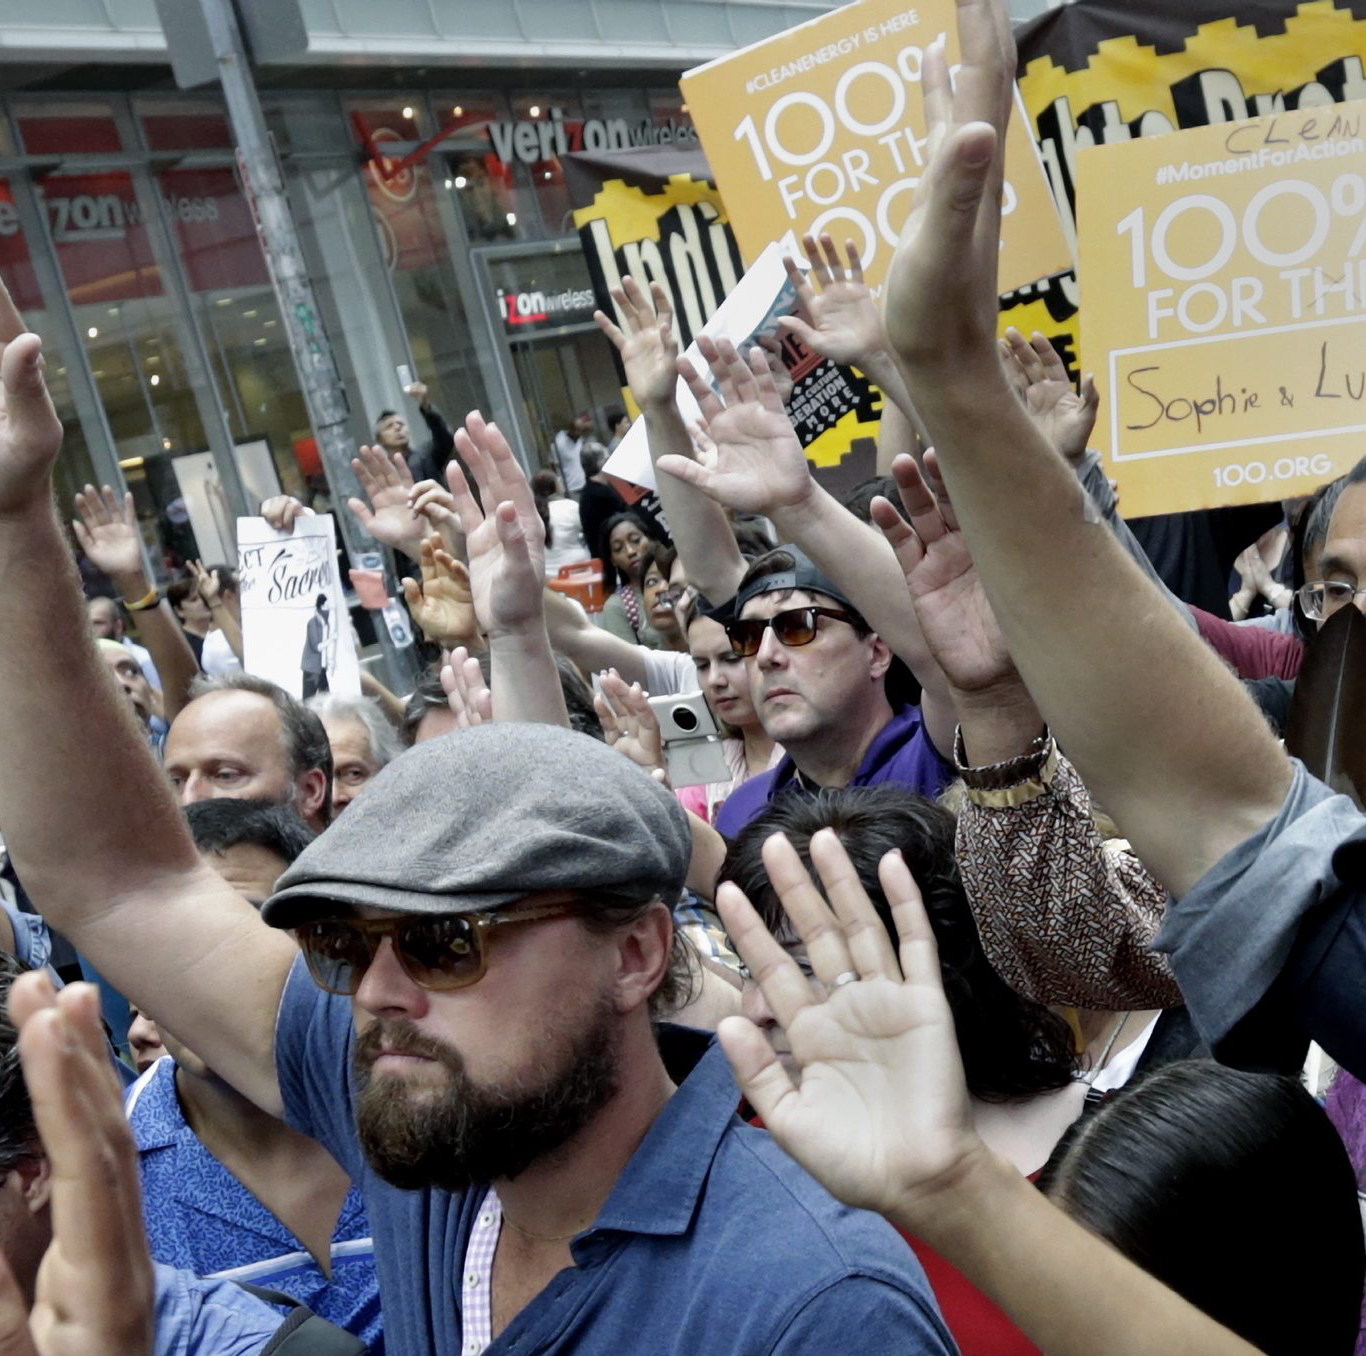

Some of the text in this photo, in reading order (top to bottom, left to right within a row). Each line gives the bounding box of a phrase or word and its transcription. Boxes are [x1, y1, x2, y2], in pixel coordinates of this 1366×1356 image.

[745, 9, 920, 94] #CLEANENERGY IS HERE
[487, 106, 629, 163] verizon
[1155, 136, 1365, 186] #MomentForAction
[777, 149, 880, 220] FOR
[1147, 276, 1267, 339] FOR
[1126, 366, 1259, 434] Sophie
[1213, 453, 1332, 488] 100.ORG
